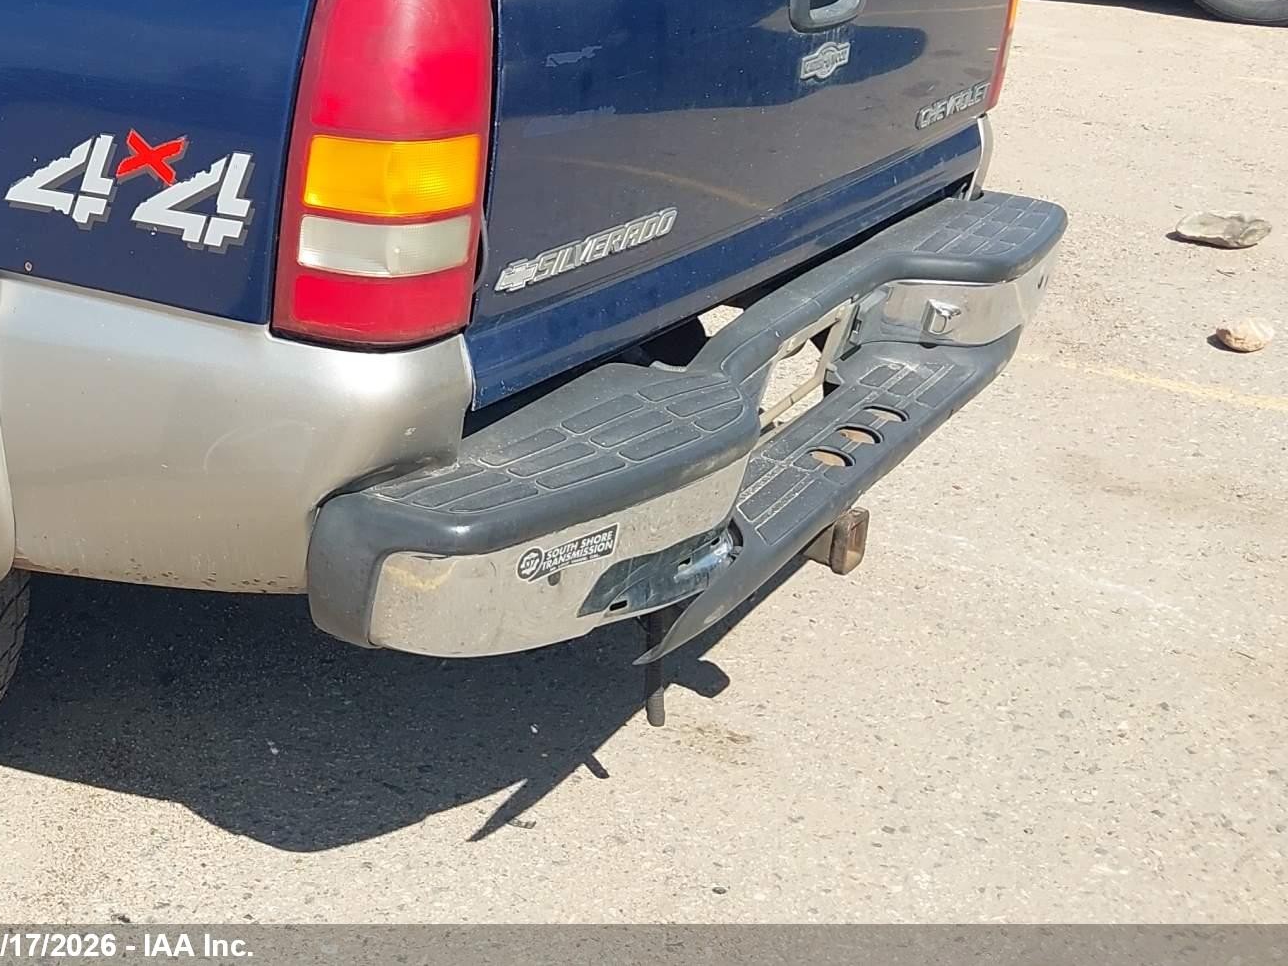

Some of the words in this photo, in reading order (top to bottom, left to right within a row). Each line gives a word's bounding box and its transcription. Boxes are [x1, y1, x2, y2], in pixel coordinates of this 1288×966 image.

[915, 81, 991, 130] CHEVROLET
[534, 206, 678, 282] SILVERADO
[541, 540, 614, 571] TRANSMISSION
[546, 541, 579, 560] SOUTH
[580, 530, 614, 548] SHORE
